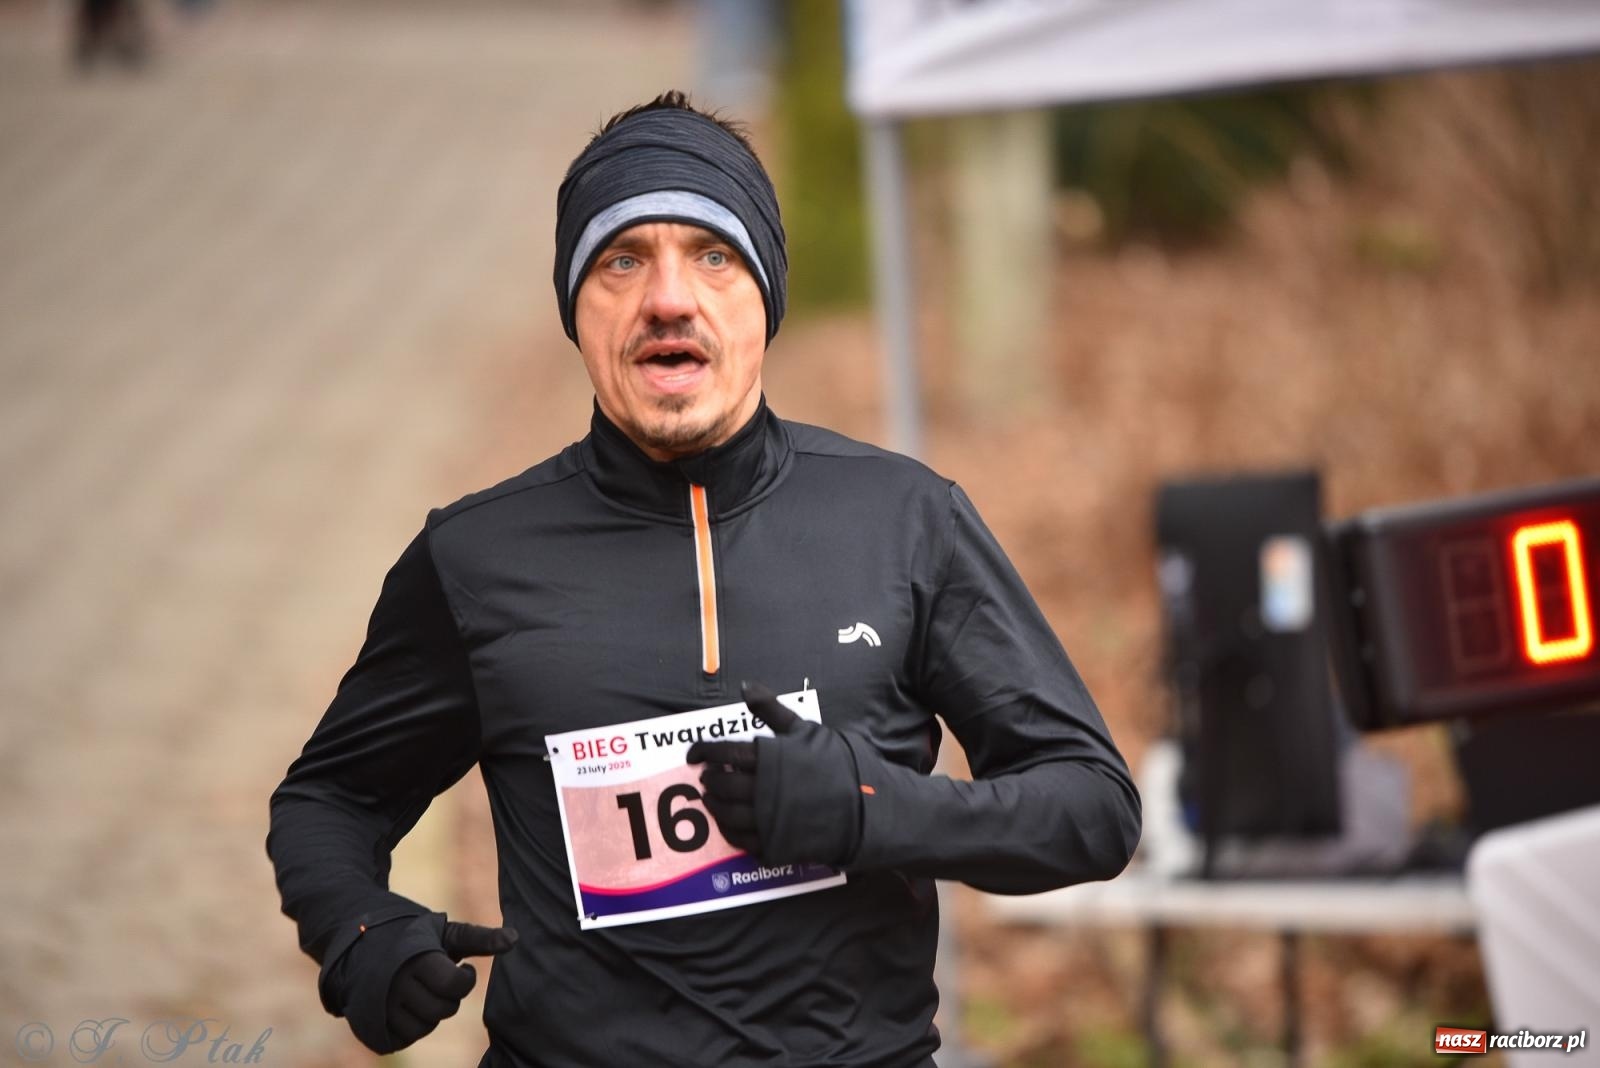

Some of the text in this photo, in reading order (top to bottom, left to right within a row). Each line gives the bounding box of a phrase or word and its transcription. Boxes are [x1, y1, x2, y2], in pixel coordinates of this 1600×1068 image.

[1512, 519, 1592, 665] 0
[572, 711, 766, 761] BIEG Twardzie
[576, 759, 632, 775] 23 luty 2025
[616, 783, 710, 860] 16
[731, 863, 794, 886] Raciborz
